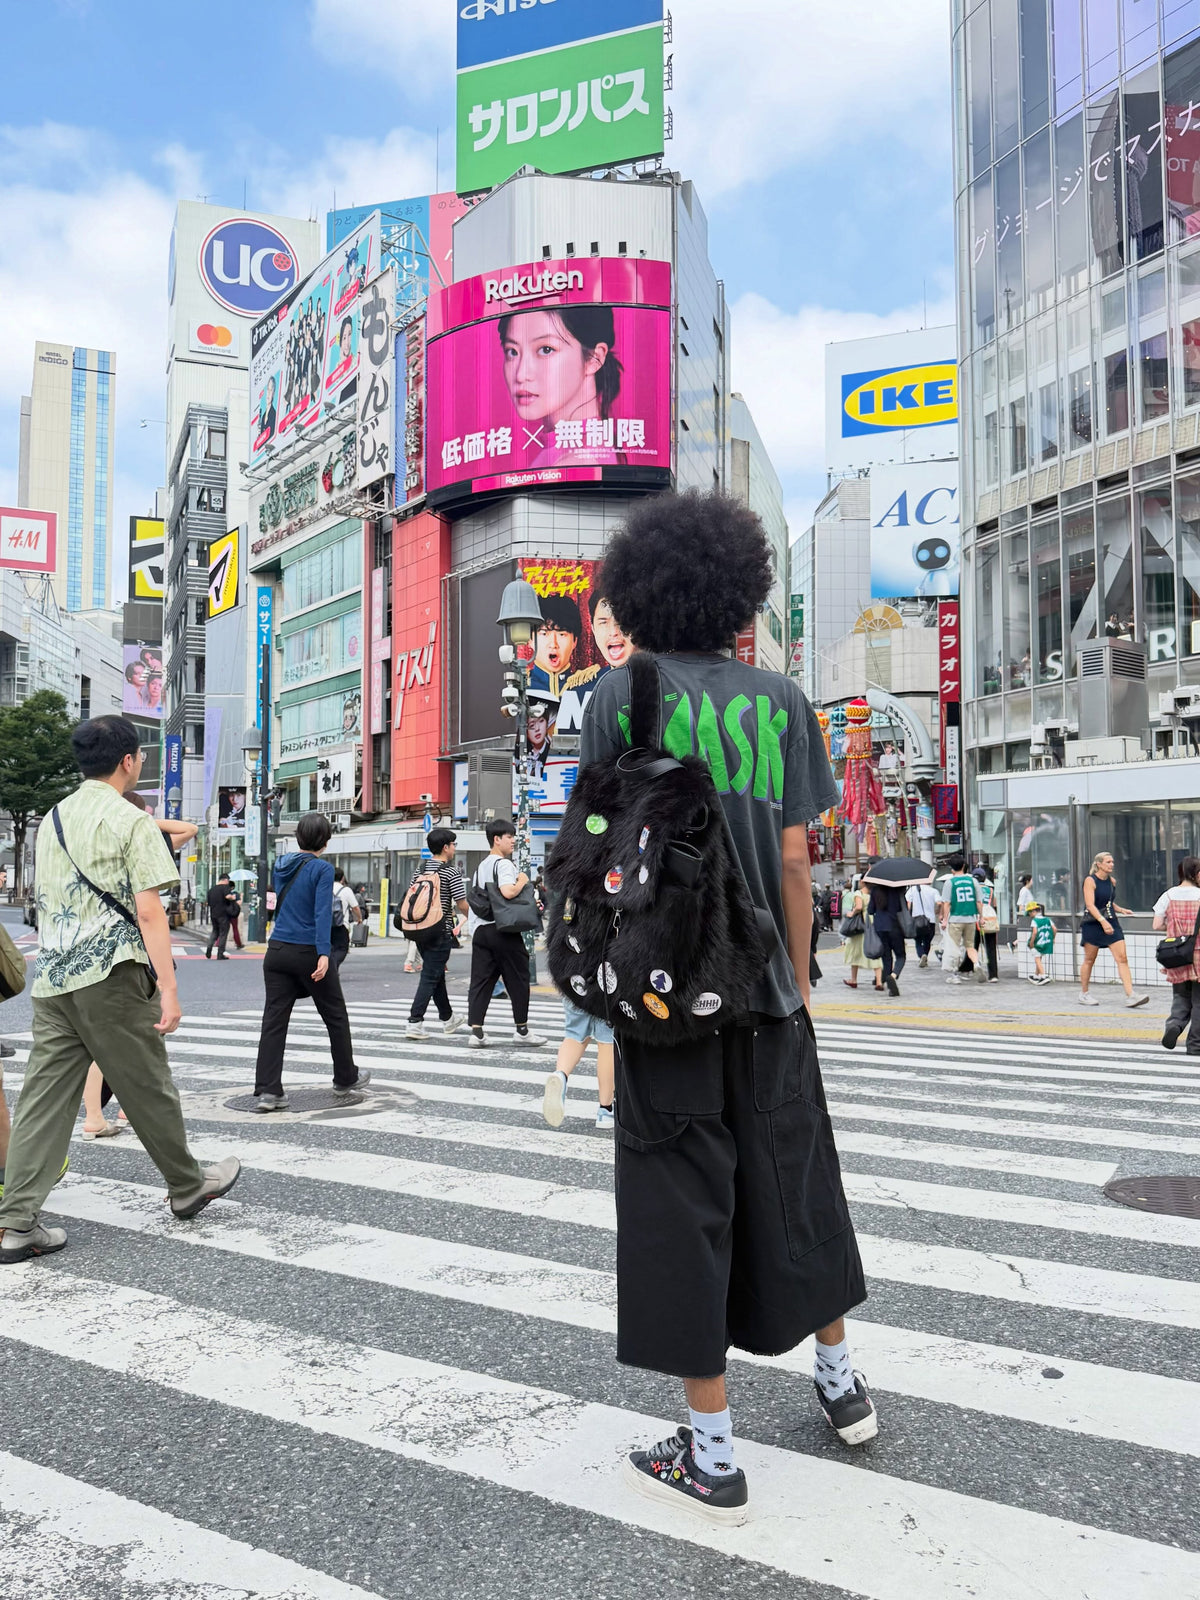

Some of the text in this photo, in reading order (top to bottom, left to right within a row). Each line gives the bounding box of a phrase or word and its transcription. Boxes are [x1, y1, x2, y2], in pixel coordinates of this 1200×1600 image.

[468, 67, 650, 152] サロンパス
[485, 269, 583, 303] Rakuten
[38, 356, 69, 366] INDIGO
[358, 282, 391, 474] もんじゃ
[859, 378, 958, 415] IKE
[441, 427, 512, 469] 低価格
[554, 417, 646, 449] 無制限
[505, 471, 562, 486] Rakuten Vision
[873, 486, 959, 529] AC
[8, 529, 41, 551] H&M
[940, 613, 958, 694] カラオケ
[395, 620, 438, 730] クスリ
[170, 742, 179, 773] MIZUHO
[956, 886, 975, 902] 62
[692, 998, 719, 1008] SHHH
